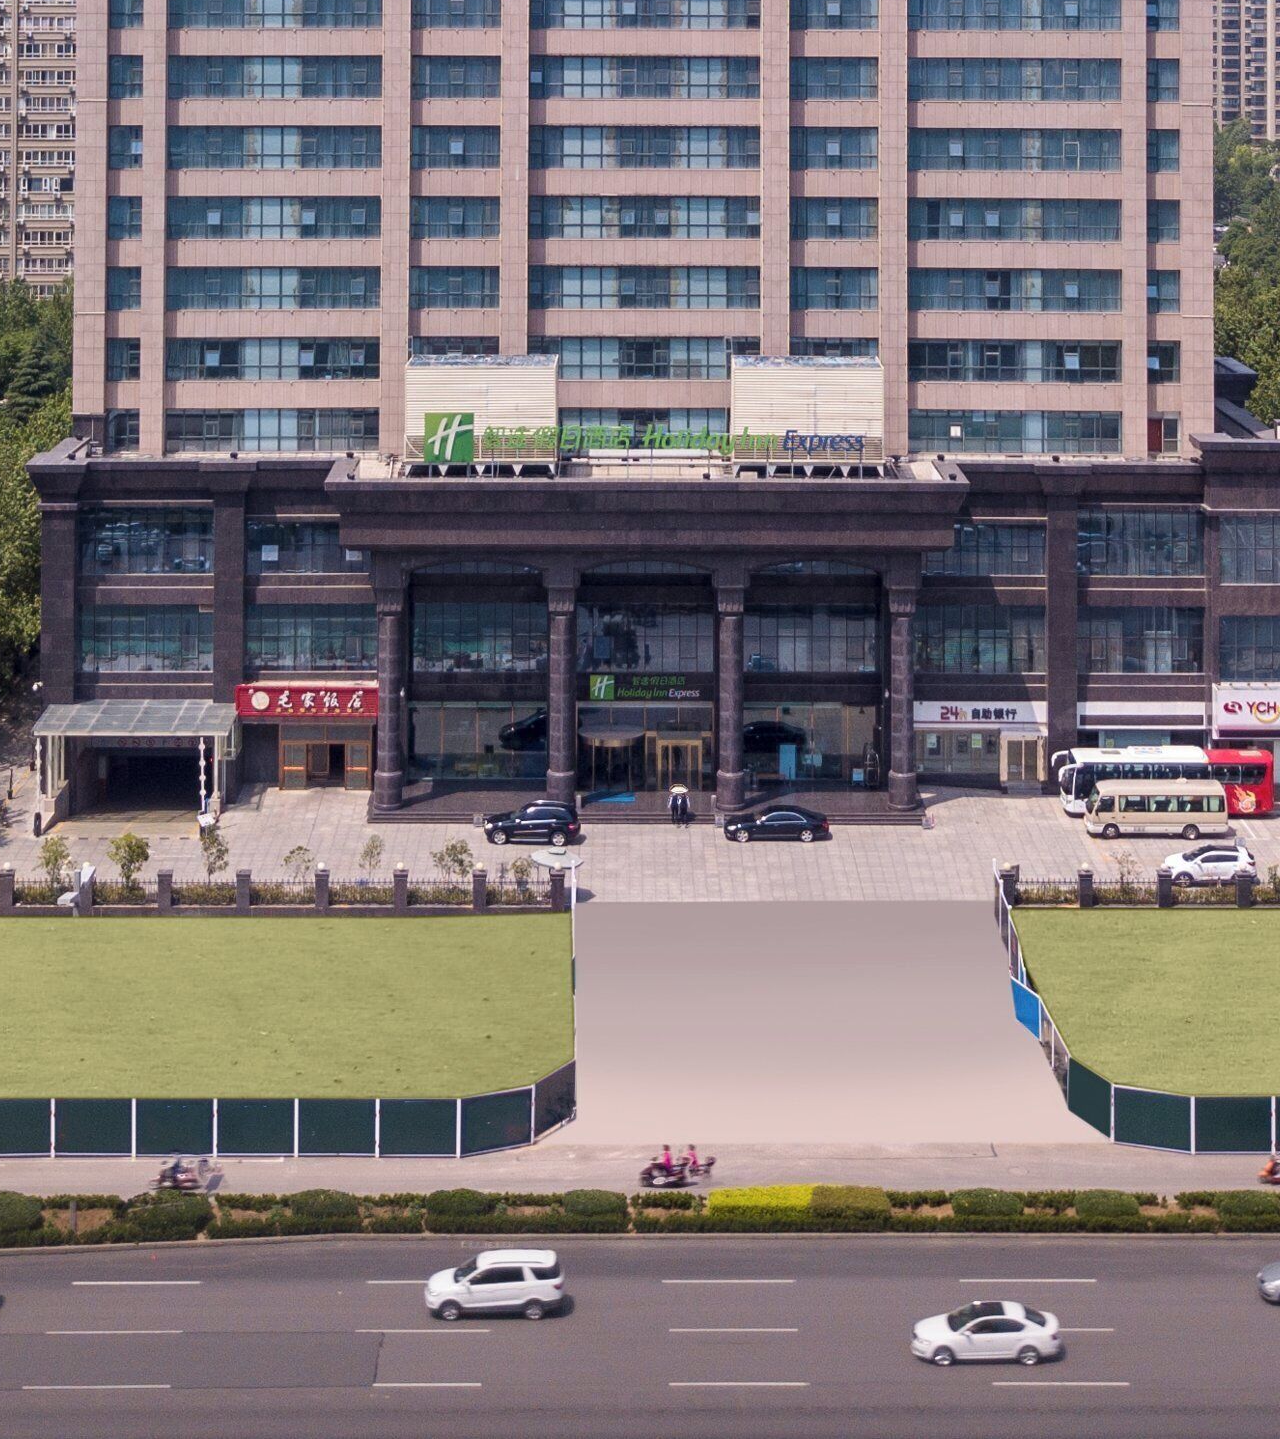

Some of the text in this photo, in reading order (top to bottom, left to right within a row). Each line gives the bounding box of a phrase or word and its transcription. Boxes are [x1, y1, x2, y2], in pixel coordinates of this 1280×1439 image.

[642, 424, 864, 456] Holiday Inn Express
[277, 690, 364, 708] 毛家饭店
[617, 688, 700, 699] Holiday Inn Express
[971, 707, 1017, 721] 自助银行
